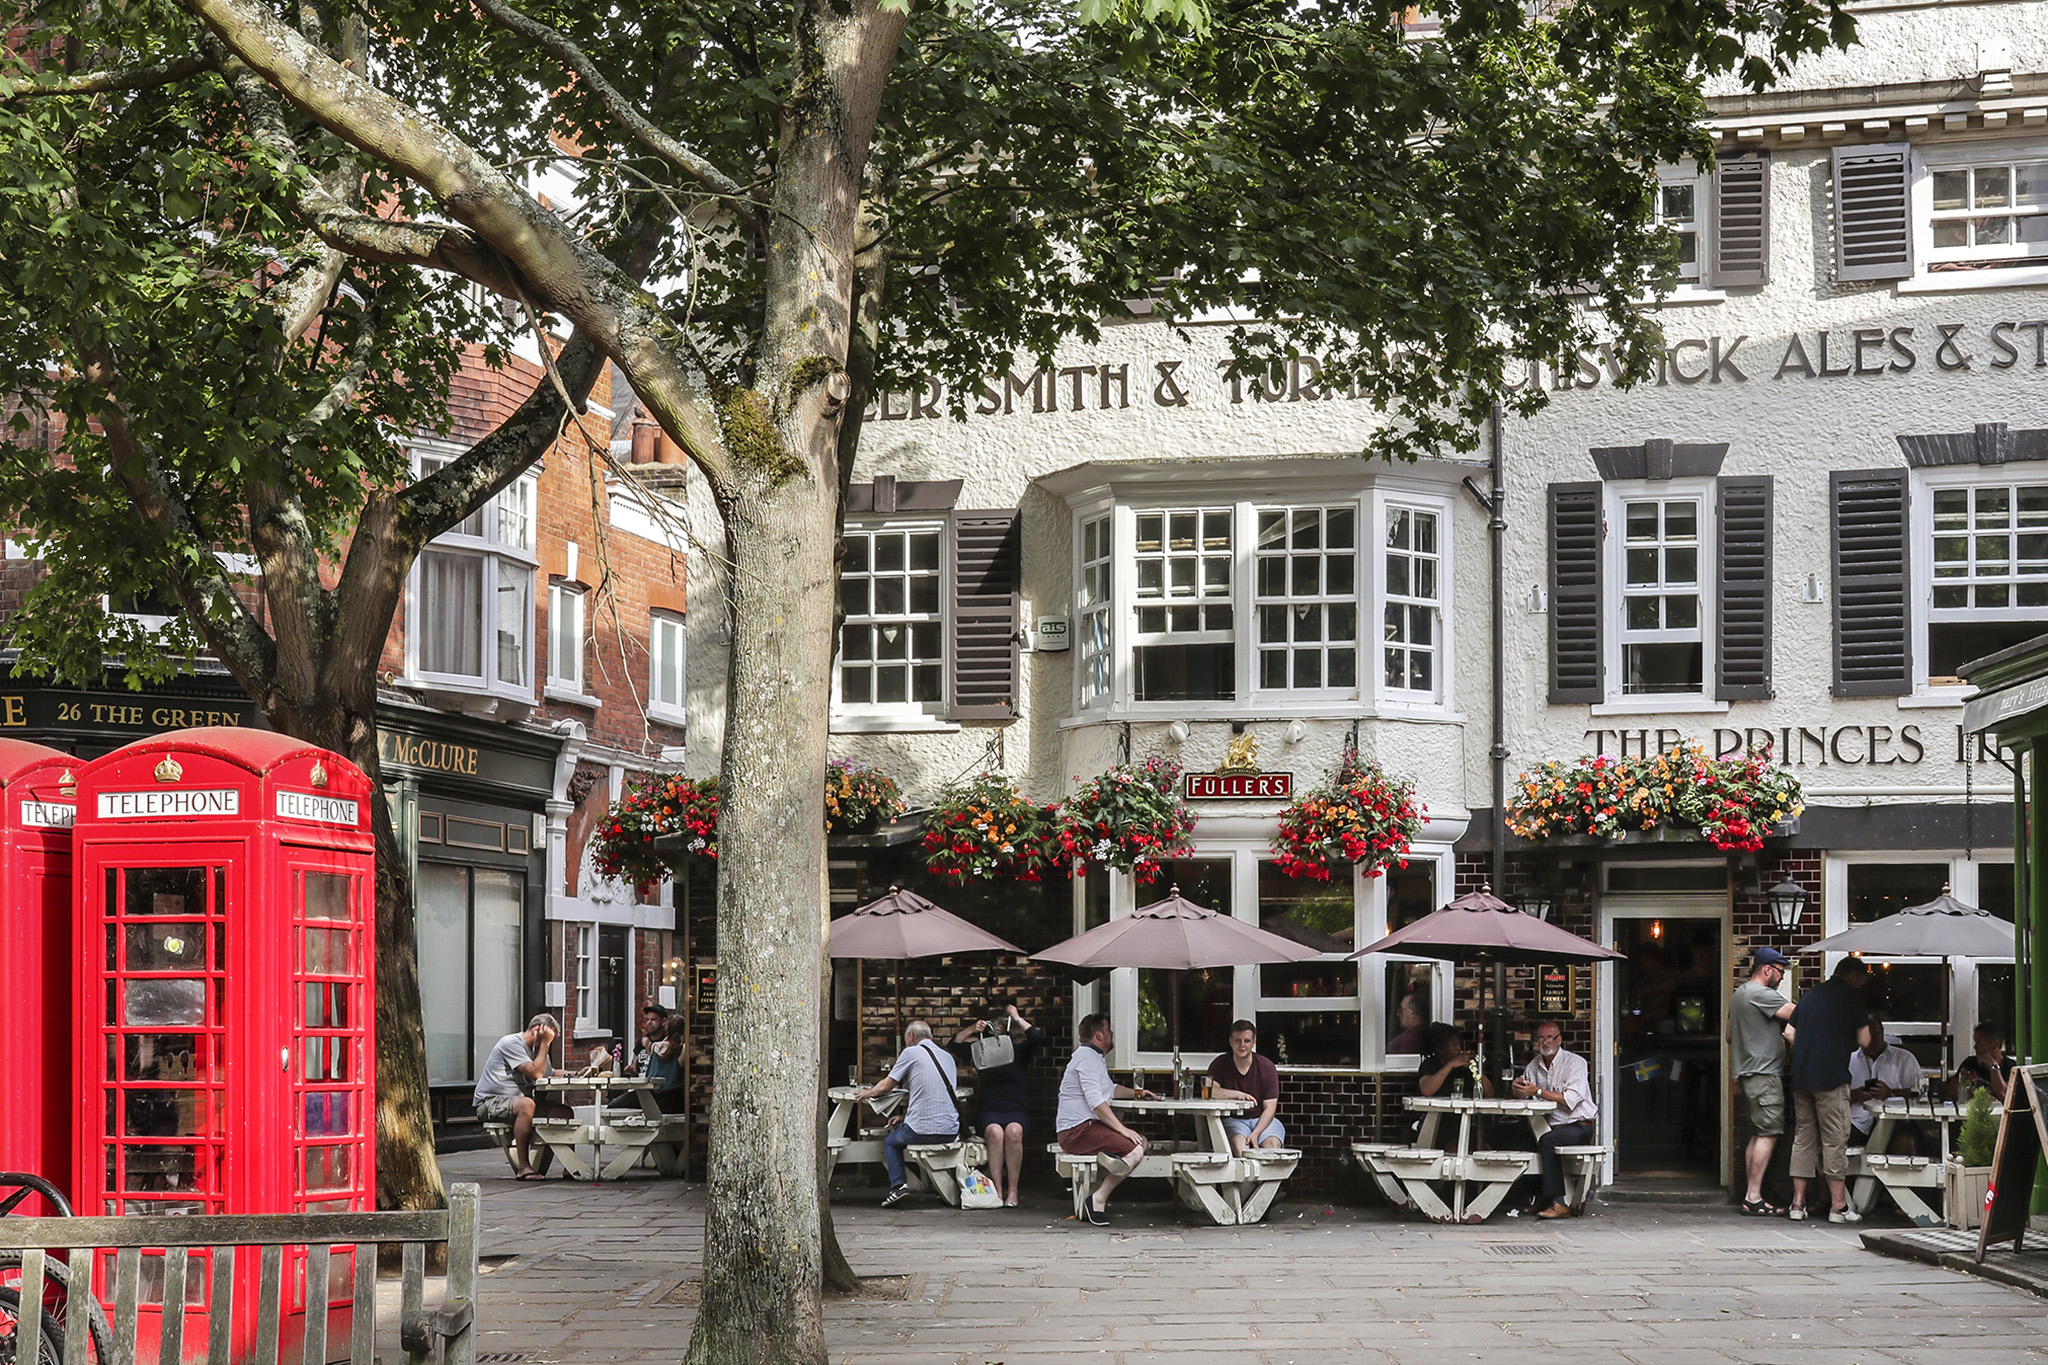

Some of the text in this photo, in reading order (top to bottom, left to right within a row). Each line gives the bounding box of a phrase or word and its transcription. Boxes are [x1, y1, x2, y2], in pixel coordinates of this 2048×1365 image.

[974, 363, 1130, 416] SMITH
[1153, 360, 1190, 407] &
[1773, 327, 1917, 380] ALES
[1936, 323, 1974, 371] &
[57, 702, 82, 721] 26
[90, 703, 144, 725] THE
[151, 707, 240, 728] GREEN
[392, 735, 478, 775] McCLURE
[1583, 728, 1682, 760] THE
[1713, 725, 1925, 766] PRINCES
[1191, 776, 1285, 796] FULLER'S
[105, 791, 237, 815] TELEPHONE
[278, 793, 356, 823] TELEPHONE
